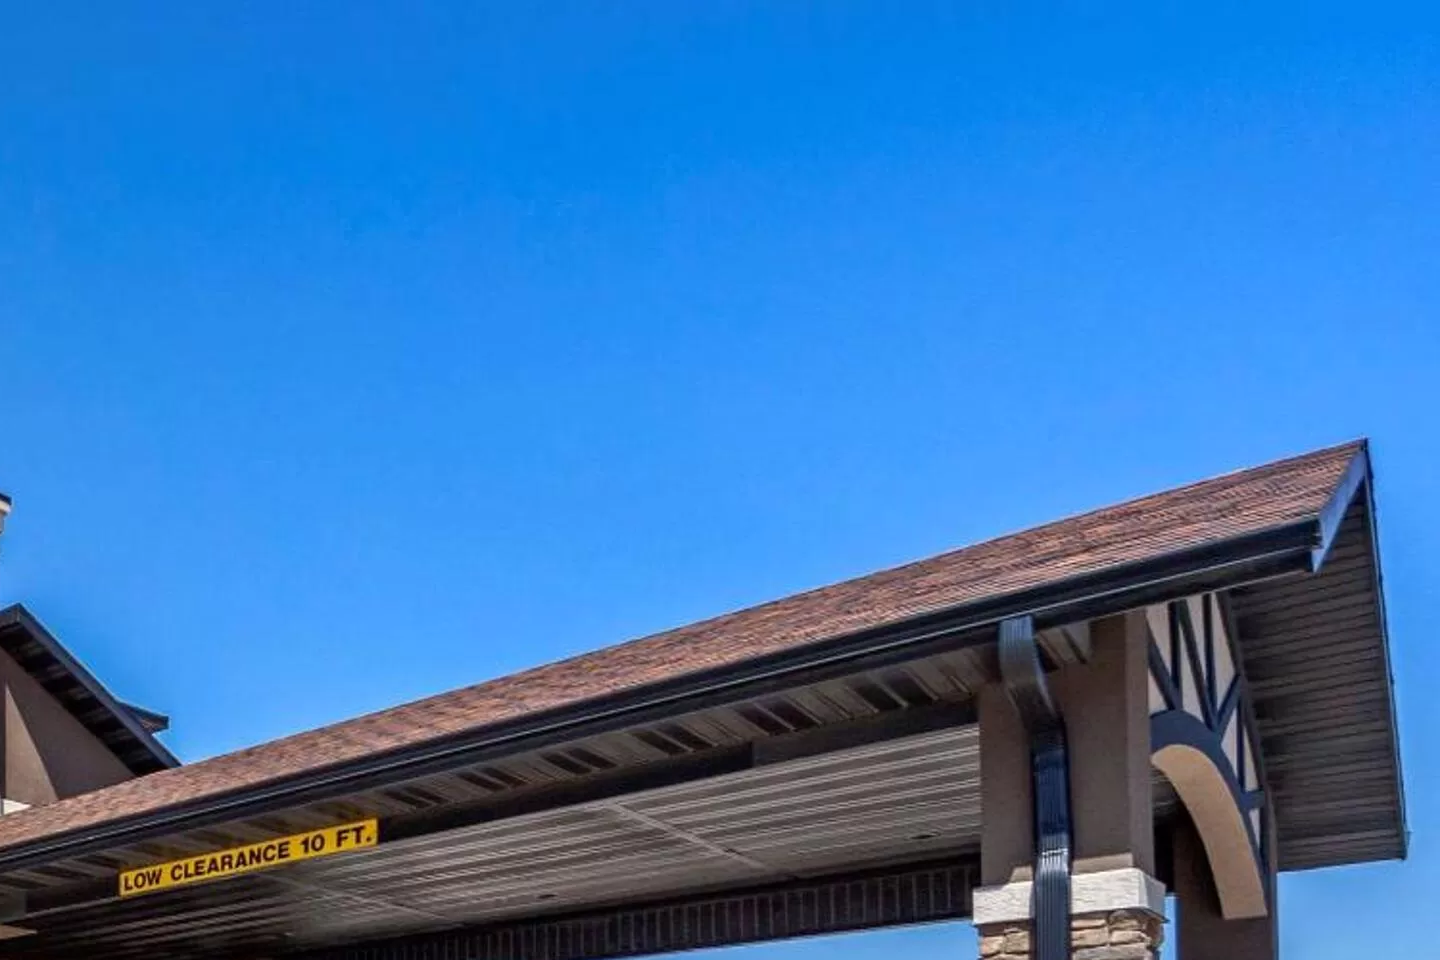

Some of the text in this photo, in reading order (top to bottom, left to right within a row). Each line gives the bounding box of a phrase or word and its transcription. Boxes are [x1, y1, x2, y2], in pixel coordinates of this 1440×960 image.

[123, 826, 372, 891] LOW CLEARANCE 10 FT.
